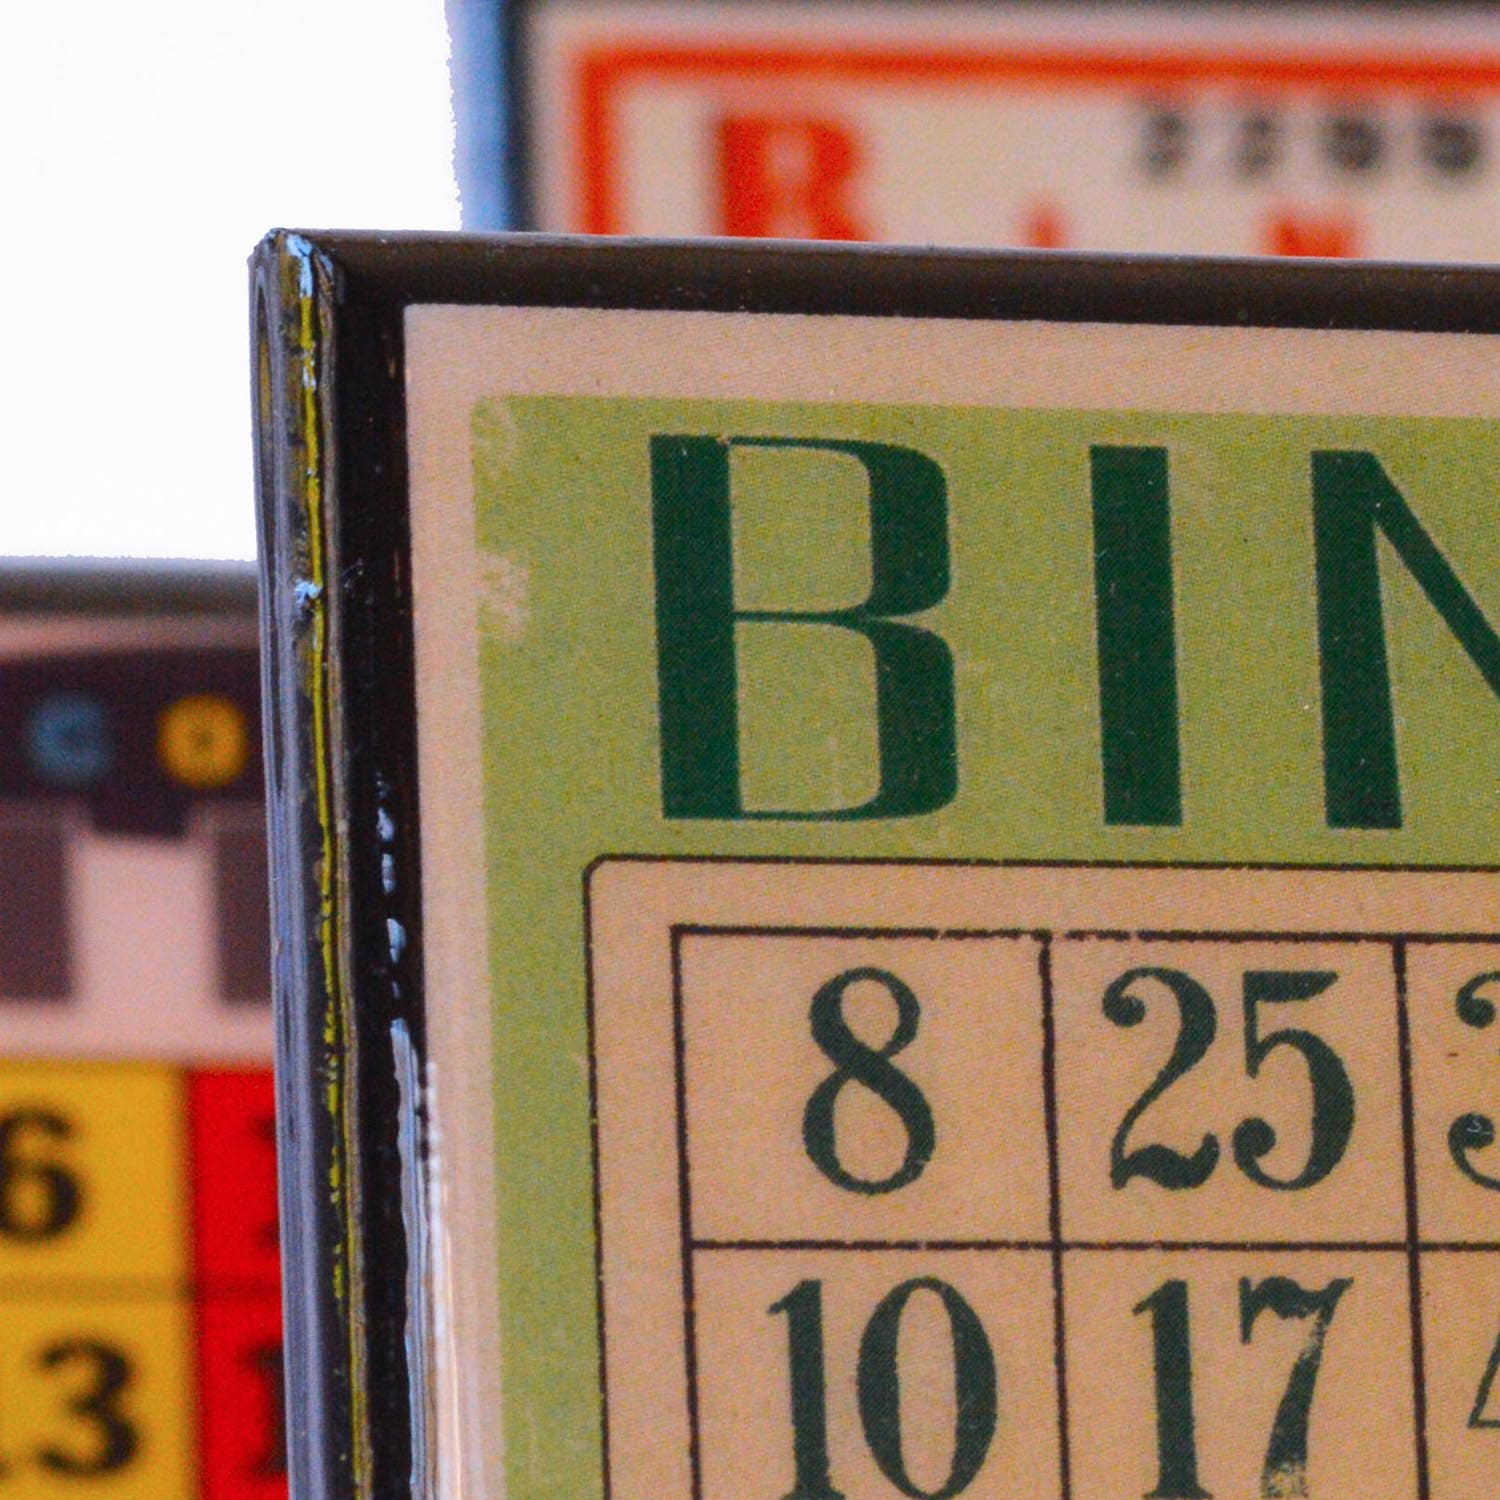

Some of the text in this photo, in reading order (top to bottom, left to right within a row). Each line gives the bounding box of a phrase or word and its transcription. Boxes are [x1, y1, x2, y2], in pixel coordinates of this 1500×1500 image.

[803, 967, 936, 1196] 8
[1102, 967, 1355, 1191] 25
[1134, 1276, 1352, 1500] 17
